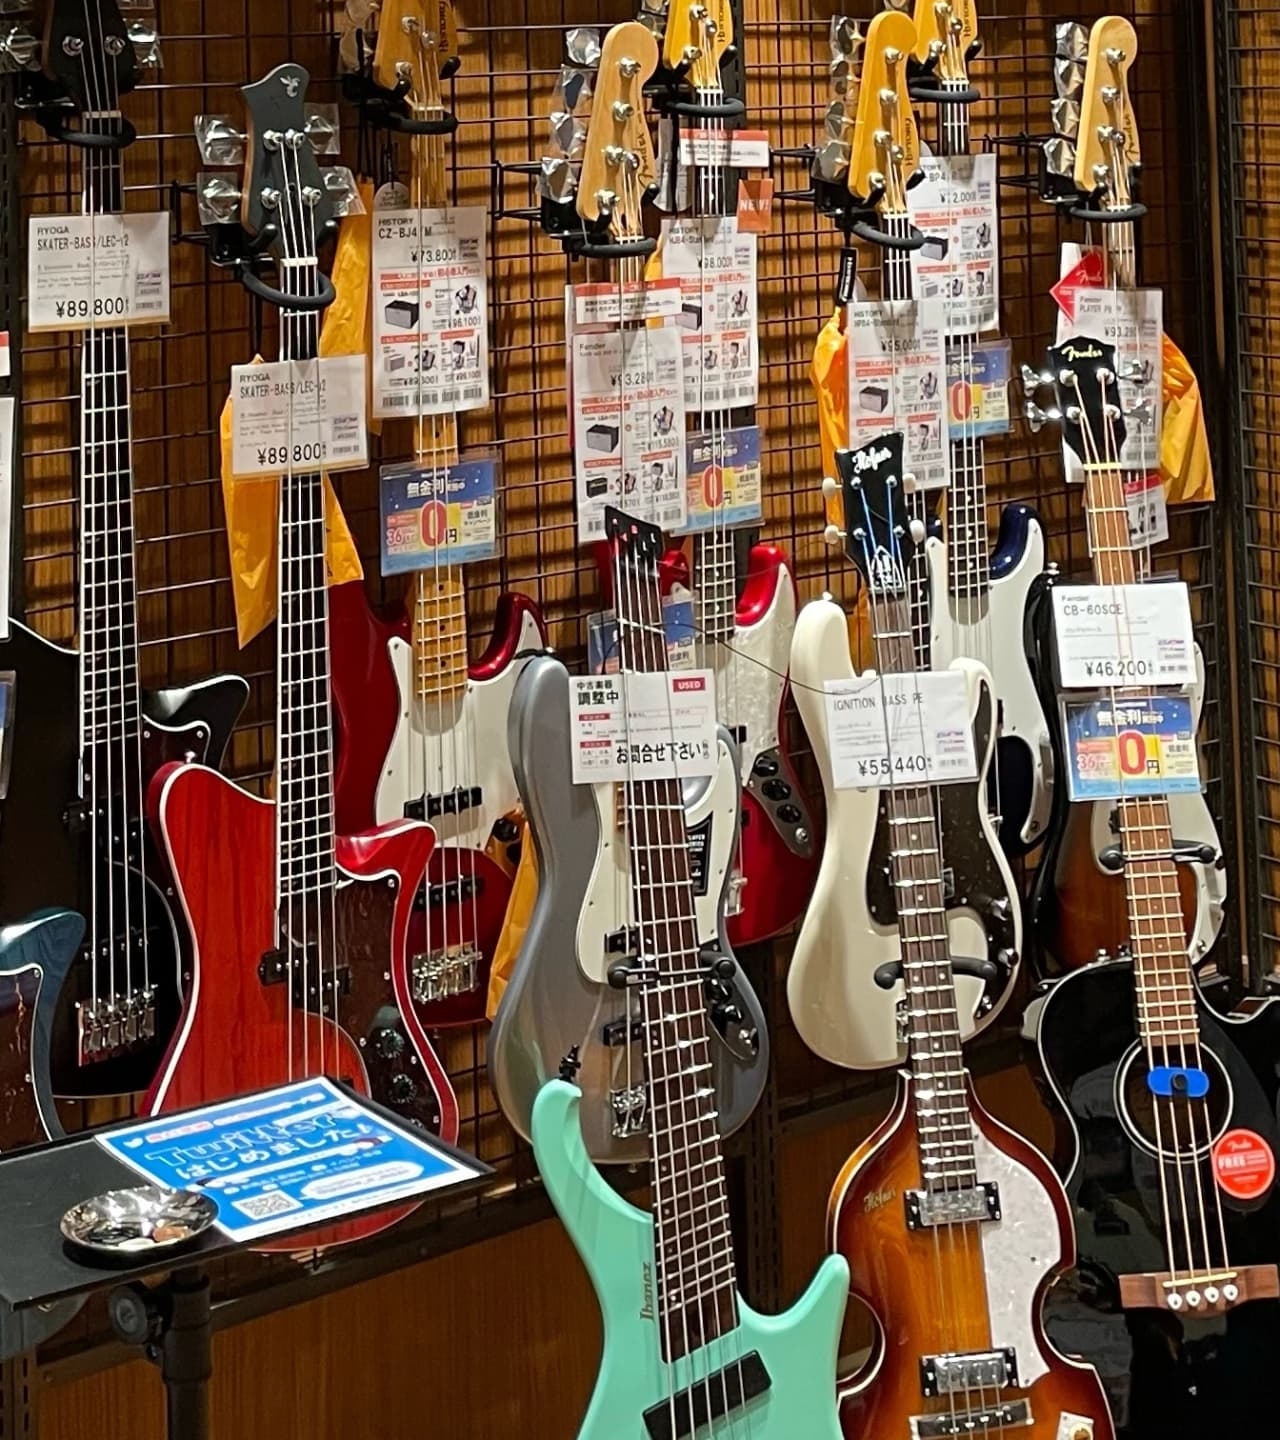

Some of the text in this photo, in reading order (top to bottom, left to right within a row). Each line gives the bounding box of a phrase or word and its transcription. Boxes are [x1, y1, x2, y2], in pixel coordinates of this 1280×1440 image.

[740, 199, 769, 211] NEW!
[378, 218, 413, 227] HISTORY
[37, 226, 70, 235] RYOGA
[239, 373, 270, 383] RYOGA
[577, 679, 701, 691] 中古楽器 USED
[577, 690, 619, 706] 調整中
[833, 696, 875, 711] IGNITION
[616, 741, 701, 765] お問合せ下さい
[145, 1111, 338, 1166] Twitter
[639, 1262, 655, 1322] Ibanez
